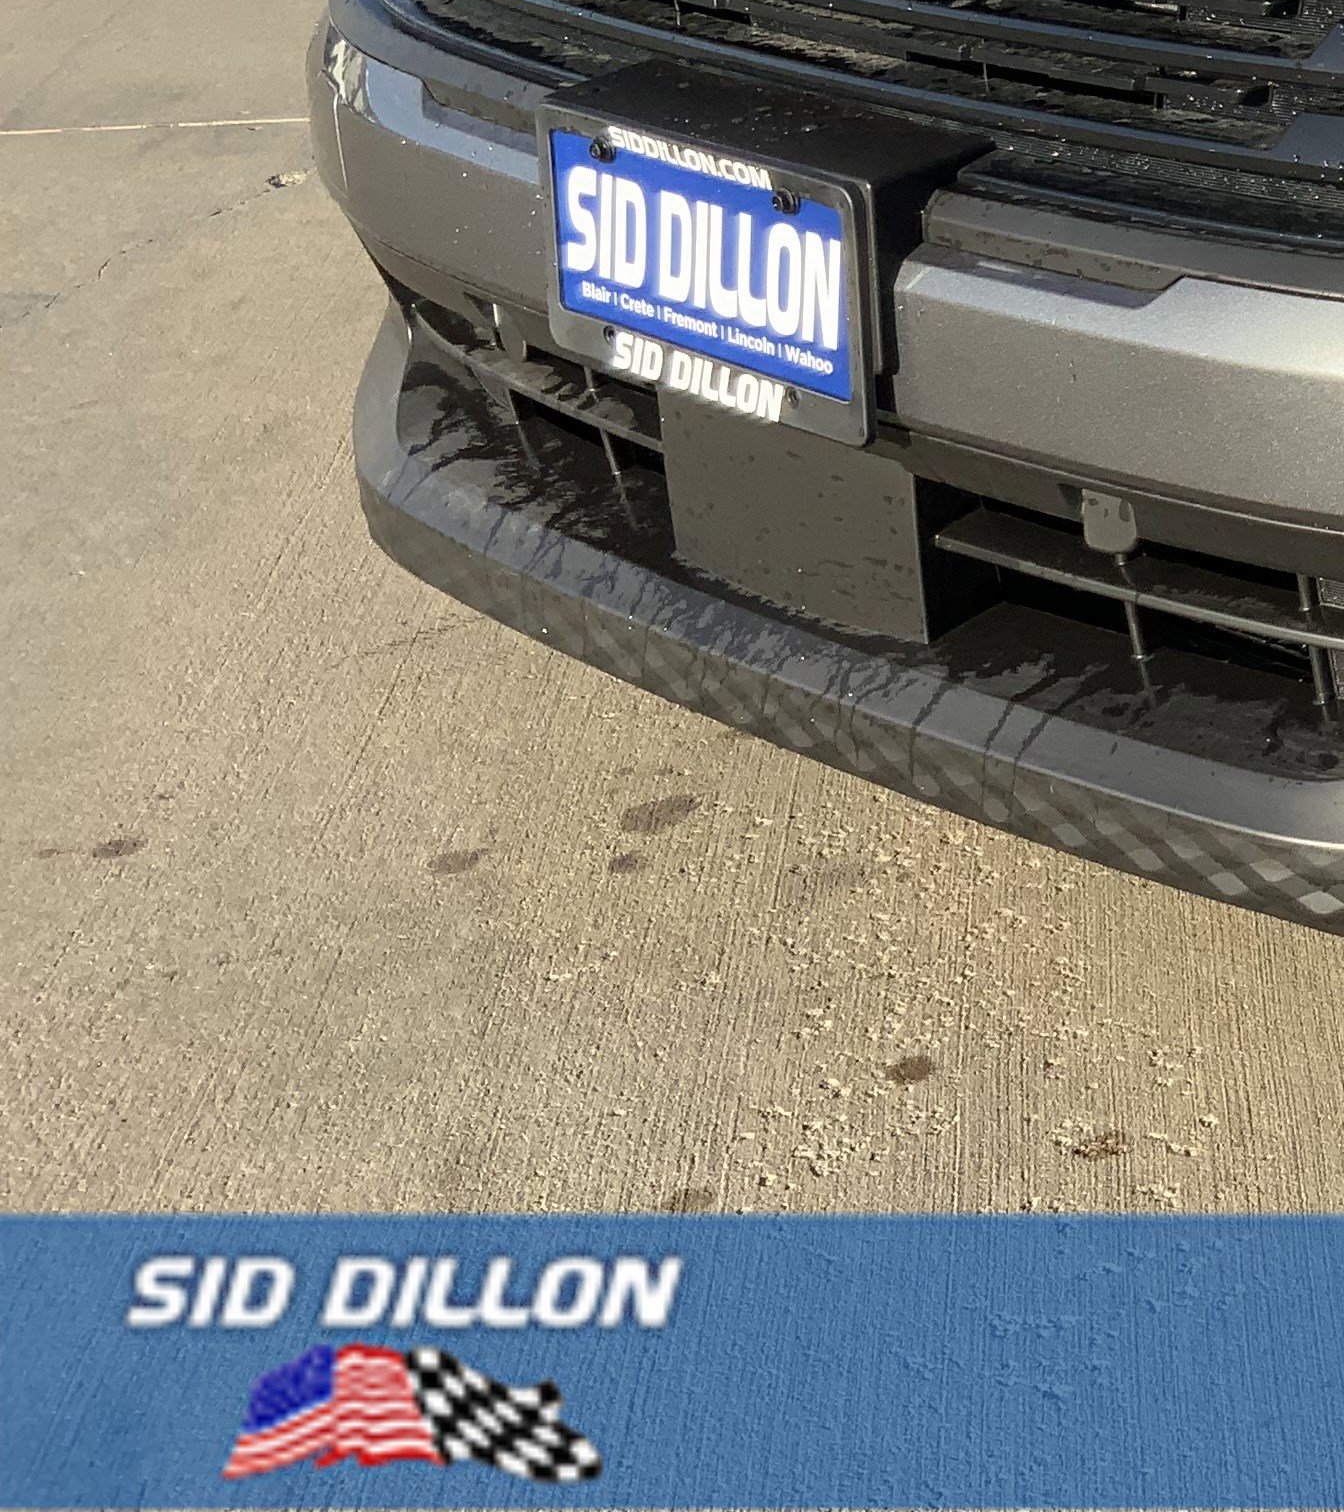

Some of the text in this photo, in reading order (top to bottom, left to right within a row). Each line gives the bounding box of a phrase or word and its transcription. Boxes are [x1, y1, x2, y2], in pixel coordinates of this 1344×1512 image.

[608, 125, 772, 190] SIDDILLON.COM
[566, 165, 841, 351] SID DILLON
[581, 281, 834, 375] Blair Crete Fremont Lincoln Wahoo
[613, 331, 785, 423] SID DILLON
